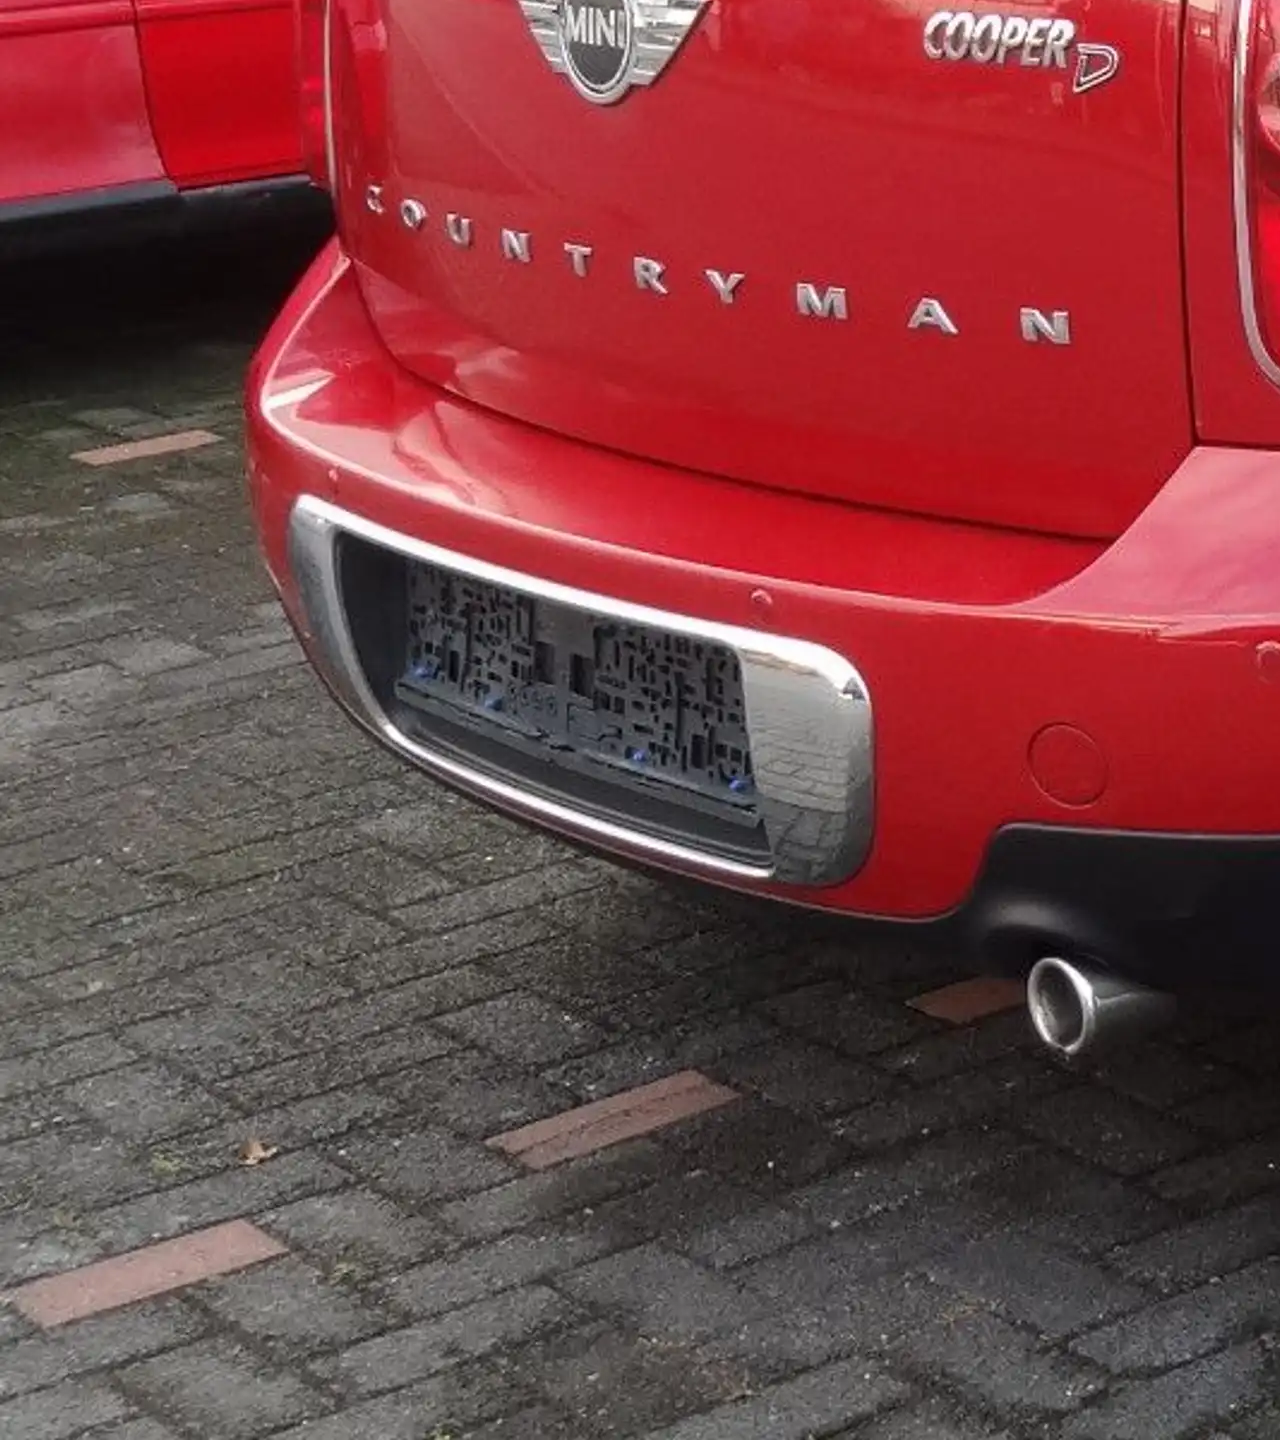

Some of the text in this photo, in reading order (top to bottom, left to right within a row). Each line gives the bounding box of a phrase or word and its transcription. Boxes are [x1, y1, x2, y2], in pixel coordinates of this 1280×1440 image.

[565, 4, 627, 48] MINI
[924, 11, 1120, 93] COOPER D
[365, 184, 1071, 345] COUNTRYMAN
